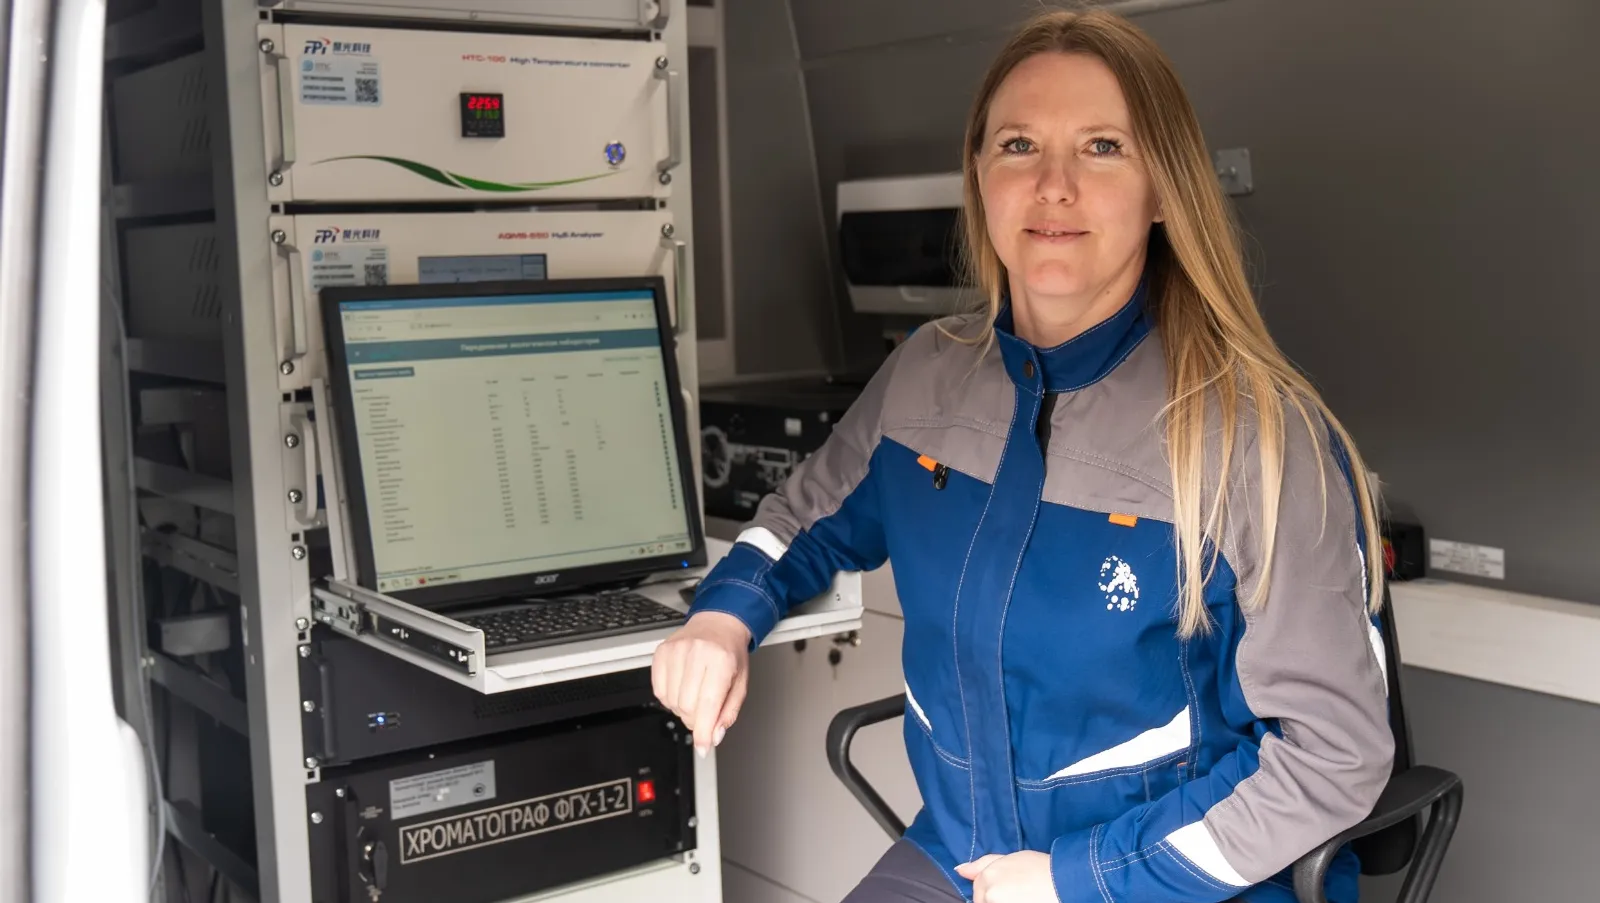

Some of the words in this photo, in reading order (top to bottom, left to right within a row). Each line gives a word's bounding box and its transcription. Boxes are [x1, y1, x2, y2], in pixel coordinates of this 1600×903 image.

[462, 54, 506, 63] HTC-100
[510, 56, 530, 65] High
[532, 57, 587, 67] Temperature
[406, 802, 550, 857] ХРОМАТОГРАФ
[554, 785, 625, 821] ФГХ-1-2
